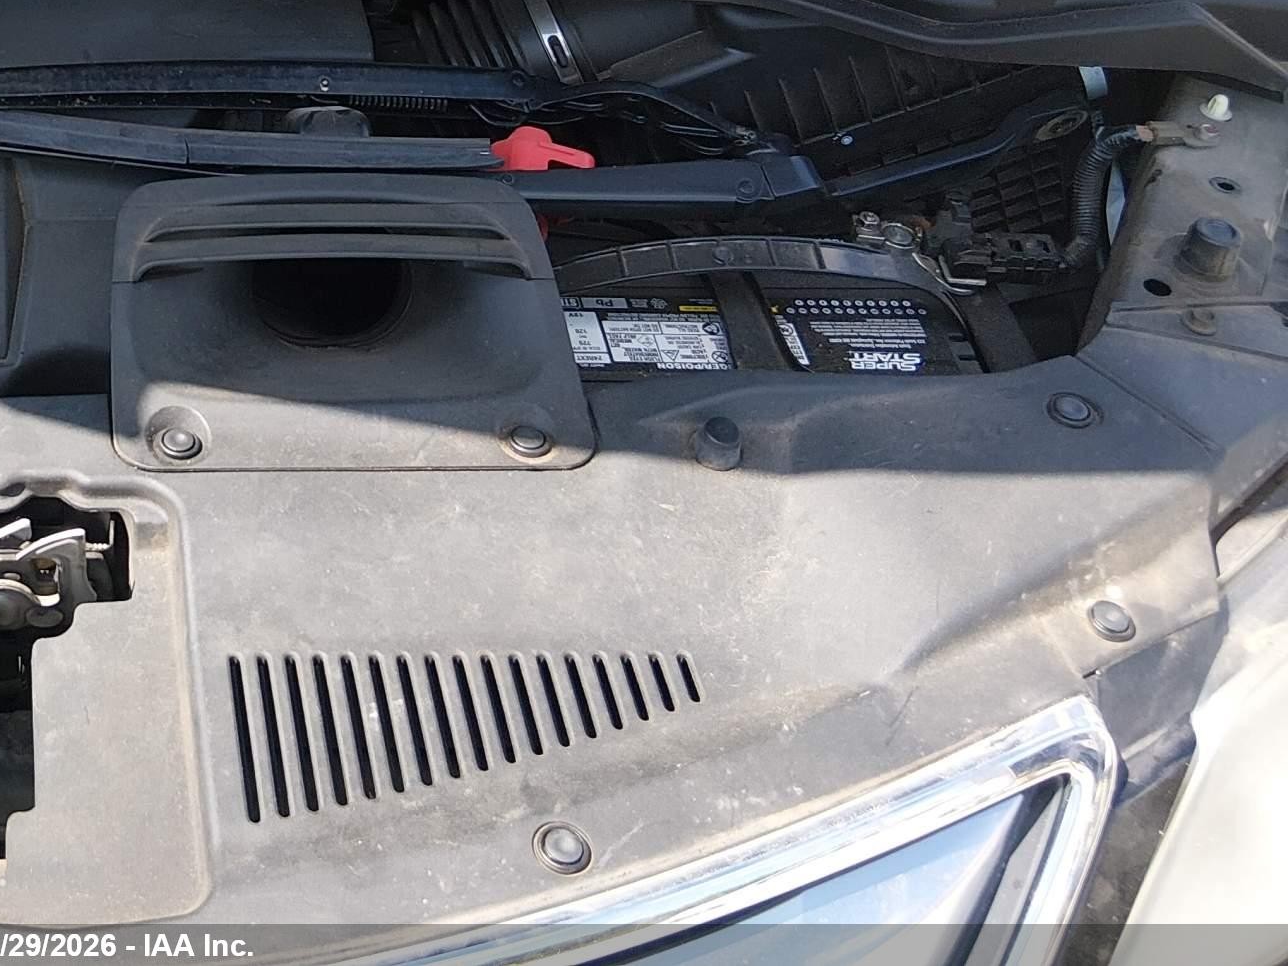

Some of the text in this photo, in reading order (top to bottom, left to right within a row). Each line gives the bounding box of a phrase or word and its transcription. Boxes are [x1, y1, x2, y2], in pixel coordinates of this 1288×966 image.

[595, 298, 614, 307] Pb
[848, 352, 921, 363] START
[851, 361, 917, 372] SUPER
